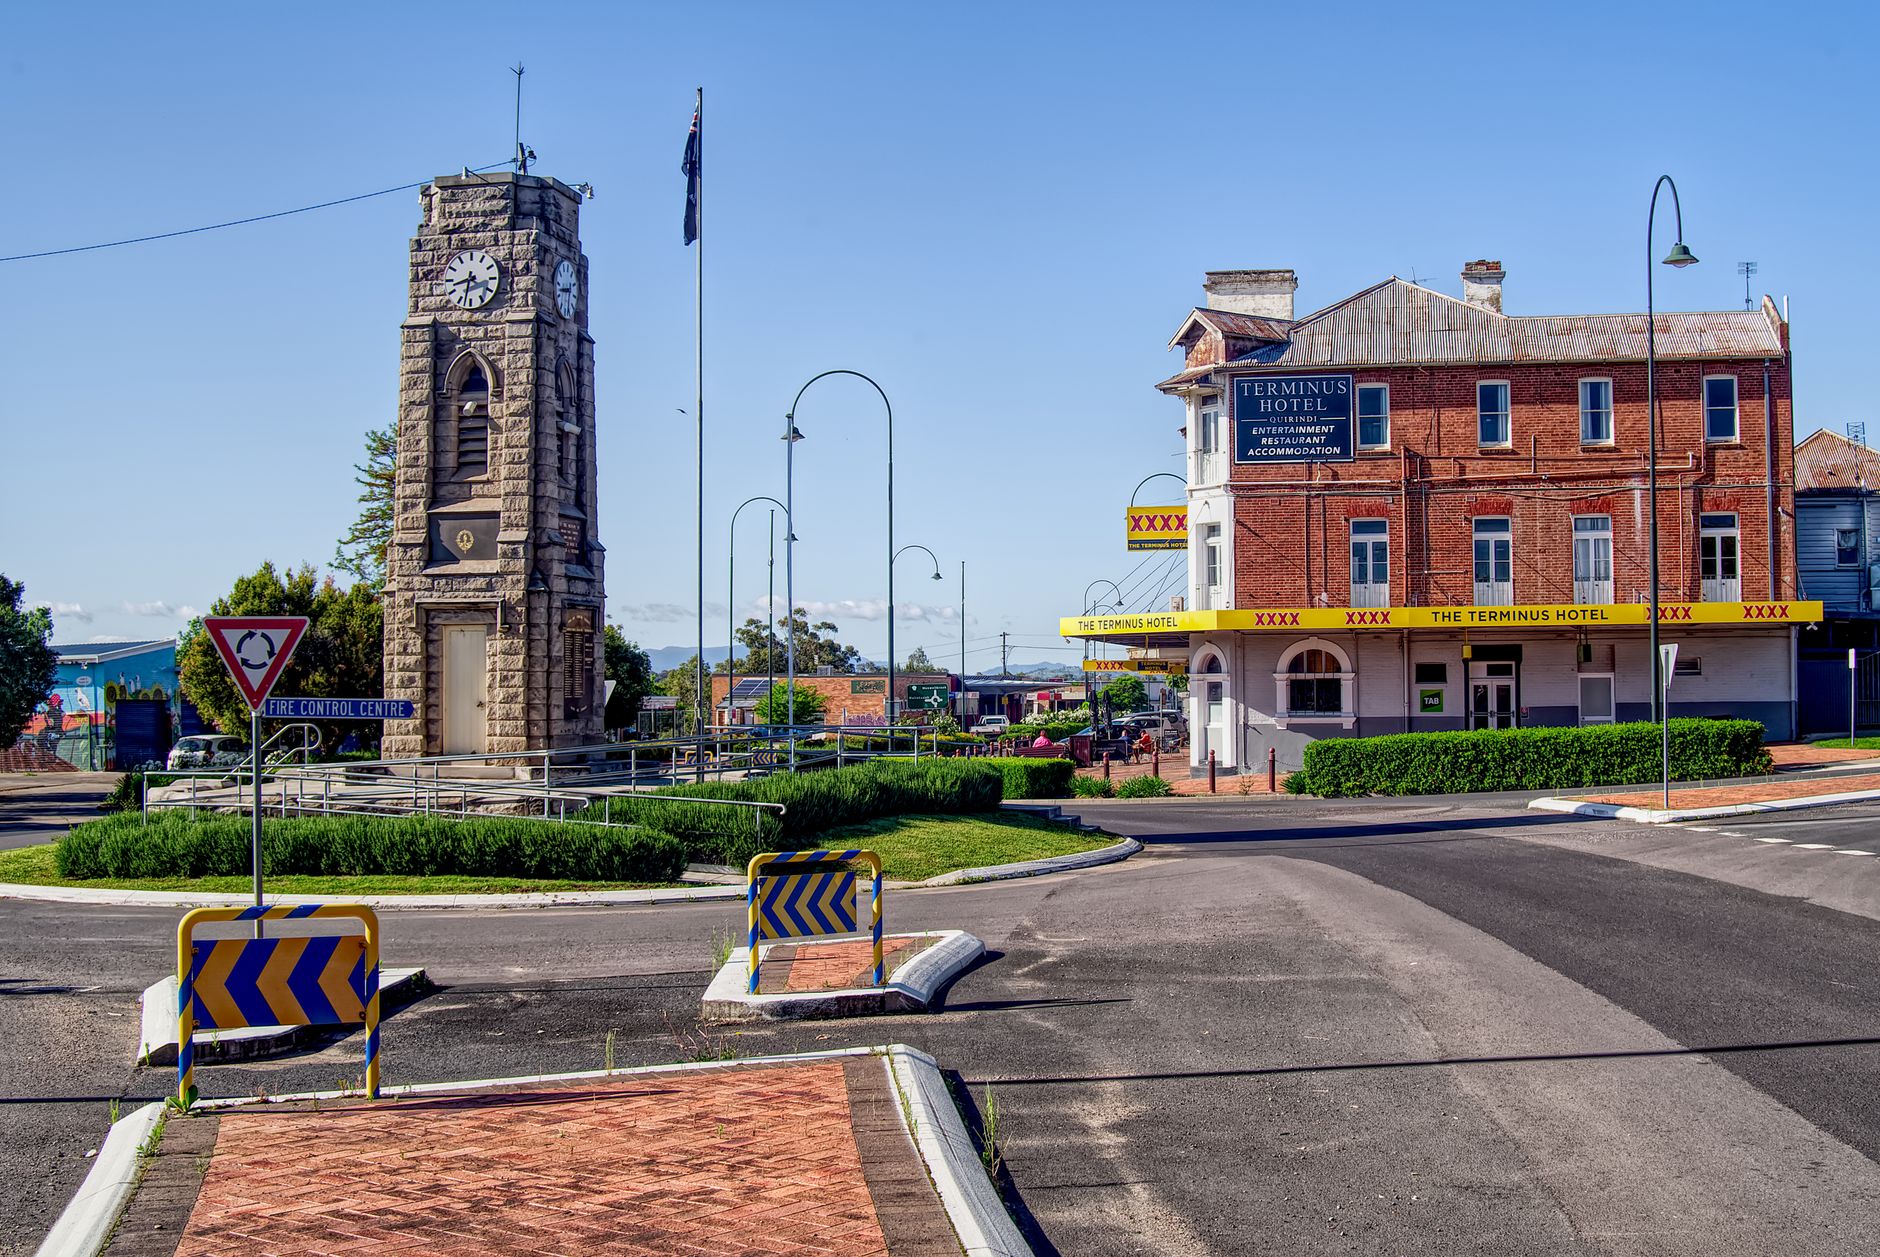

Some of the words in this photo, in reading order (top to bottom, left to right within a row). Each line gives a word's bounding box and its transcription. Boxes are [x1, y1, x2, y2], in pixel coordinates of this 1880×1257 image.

[1240, 380, 1347, 396] TERMINUS
[1259, 398, 1328, 412] HOTEL
[1269, 415, 1317, 423] QUIRINDI
[1252, 425, 1335, 435] ENTERTAINMENT
[1261, 436, 1326, 445] RESTAURANT
[1247, 446, 1341, 456] ACCOMMODATION
[1129, 514, 1188, 532] XXXX
[1345, 611, 1391, 625] XXXX
[1432, 611, 1462, 622] THE
[1468, 610, 1550, 622] TERMINUS
[1556, 609, 1609, 621] HOTEL
[1743, 604, 1790, 619] XXXX
[1078, 620, 1095, 631] THE
[1098, 618, 1143, 630] TERMINUS
[1146, 617, 1178, 628] HOTEL
[1254, 612, 1300, 626] XXXX
[1095, 661, 1124, 671] XXXX
[1424, 697, 1440, 705] TAB
[269, 700, 295, 715] FIRE
[300, 701, 354, 716] CONTROL
[360, 701, 405, 717] CENTRE
